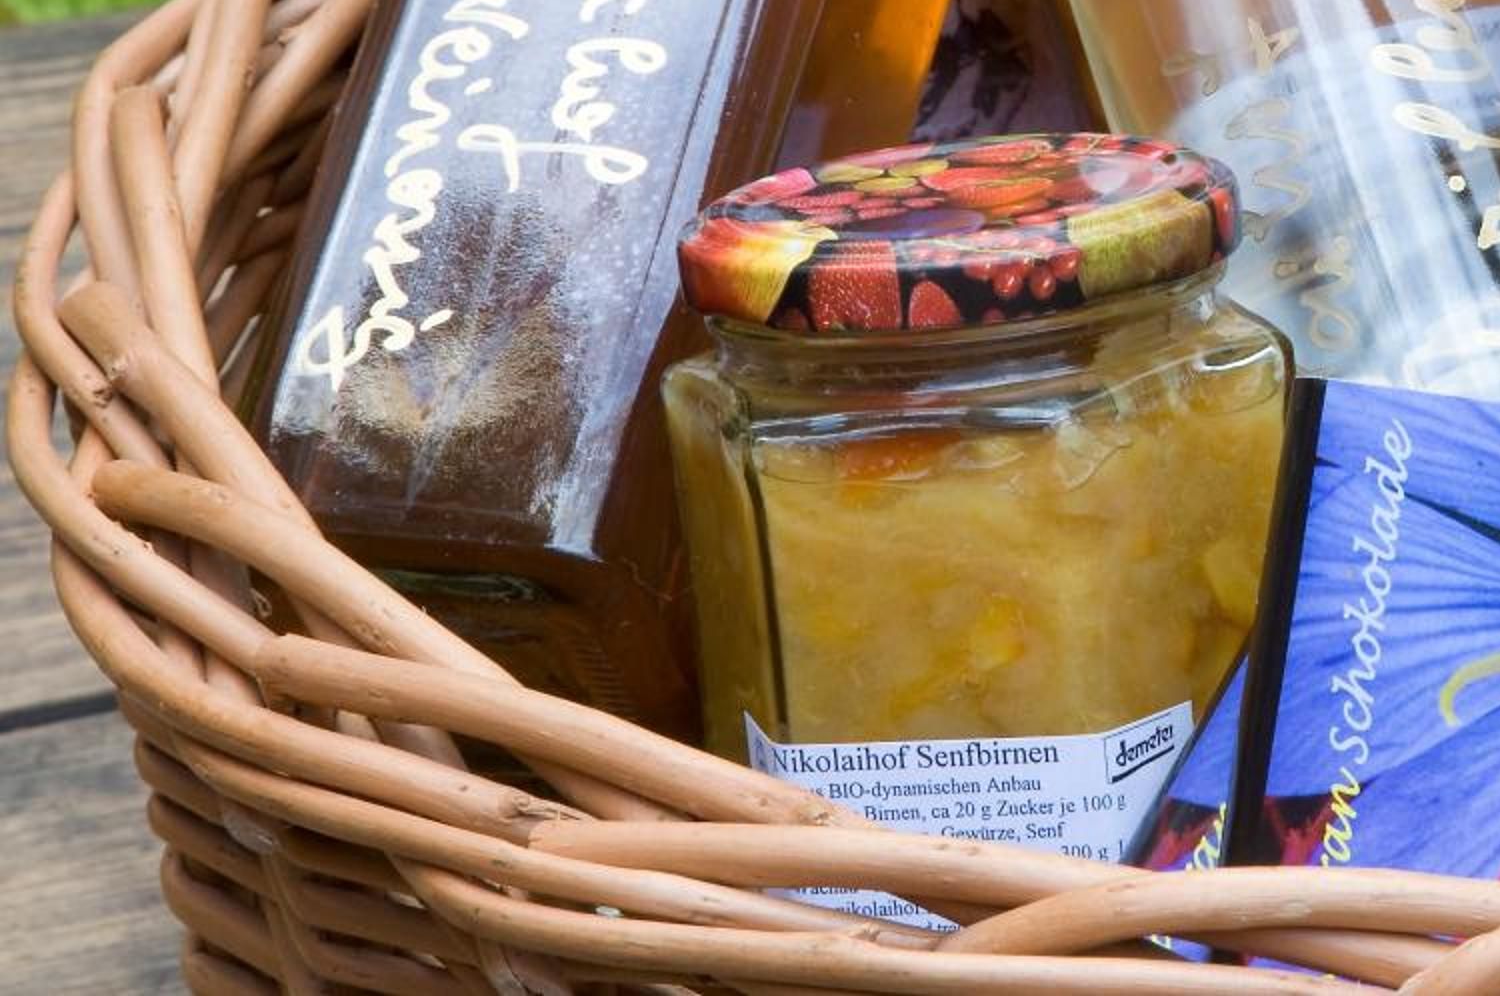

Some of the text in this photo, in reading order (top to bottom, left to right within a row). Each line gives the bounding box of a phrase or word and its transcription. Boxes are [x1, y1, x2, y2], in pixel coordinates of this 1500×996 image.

[1327, 418, 1414, 765] Schokolade
[773, 745, 911, 773] Nikolaihof
[916, 740, 1060, 769] Senfbirnen
[1115, 724, 1174, 767] demeter
[828, 776, 982, 801] BIO-dynamischen
[987, 775, 1042, 794] Anbau
[864, 793, 1127, 822] Birnen, ca 20 g Zucker je 100 g
[1025, 821, 1065, 840] Senf
